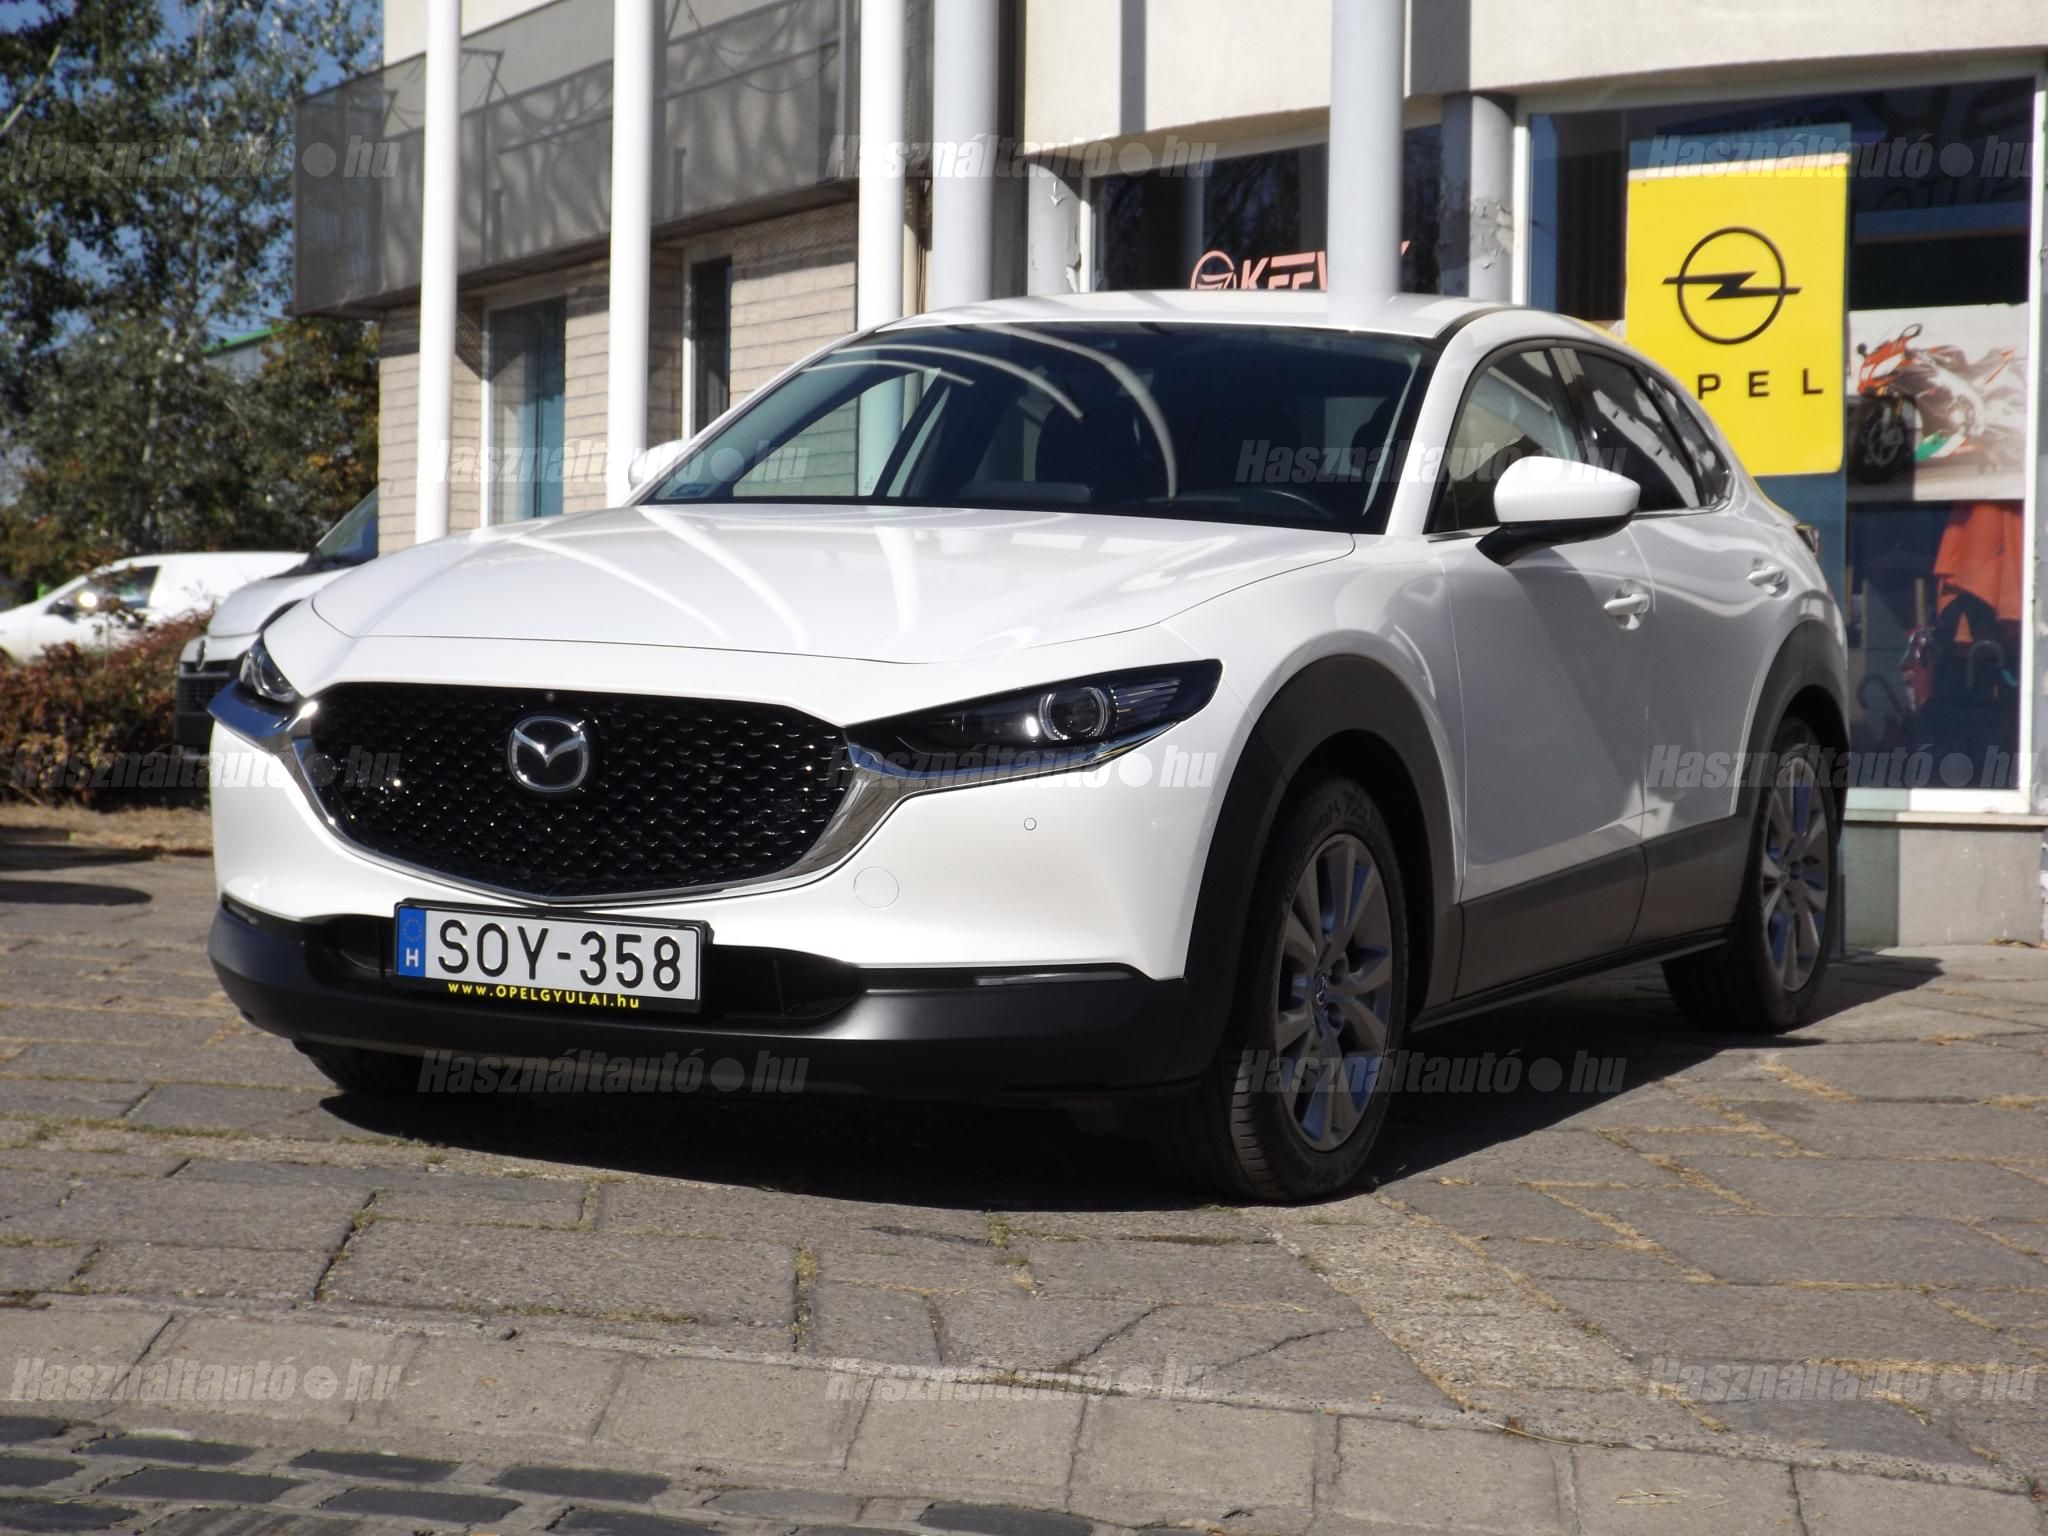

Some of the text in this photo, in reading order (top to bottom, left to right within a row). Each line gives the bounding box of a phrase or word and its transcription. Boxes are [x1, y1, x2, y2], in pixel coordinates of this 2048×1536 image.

[1697, 367, 1824, 400] PEL
[405, 948, 419, 968] H
[438, 919, 681, 991] SOY-358
[448, 982, 640, 1009] www.OPELGYULAI.hu
